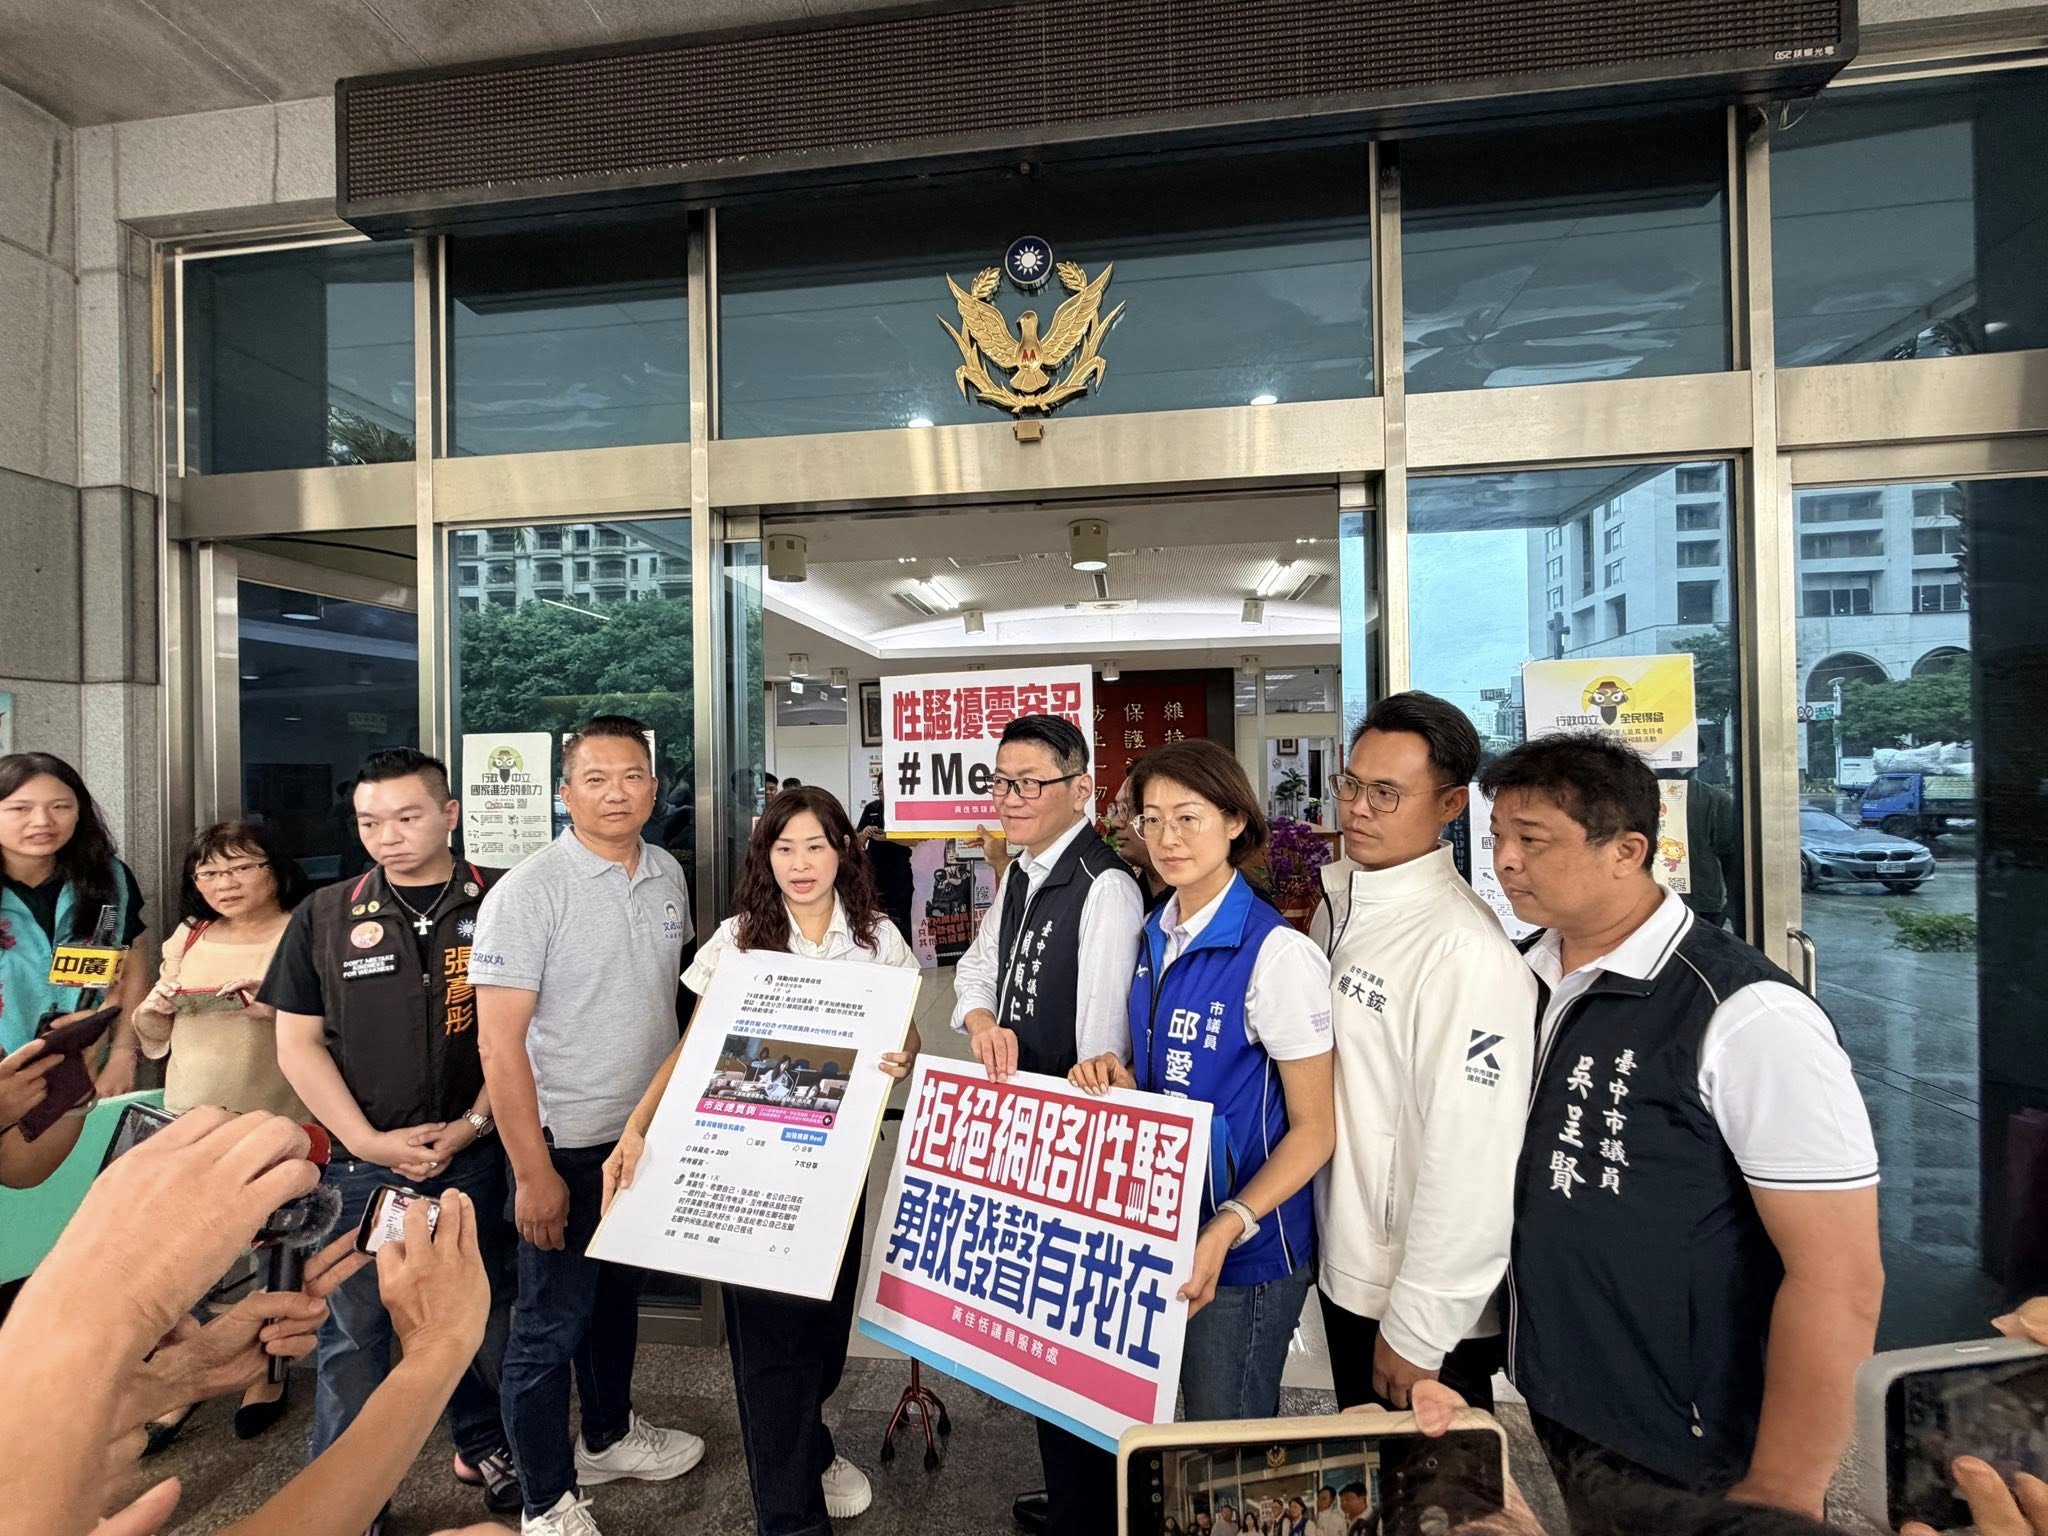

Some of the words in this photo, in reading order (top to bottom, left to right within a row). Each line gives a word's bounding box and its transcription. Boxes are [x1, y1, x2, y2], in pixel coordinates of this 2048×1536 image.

[1556, 715, 1600, 726] 行政中立
[1620, 712, 1664, 724] 全民得益
[471, 784, 543, 796] 國家進步的動力
[482, 773, 499, 783] 行政
[512, 773, 531, 783] 中立
[53, 956, 110, 975] 中廣
[343, 970, 357, 978] FOR
[358, 965, 395, 976] WEAKNESS
[1350, 965, 1385, 988] 台中市議員
[1203, 1001, 1225, 1051] 市議員
[1549, 1055, 1594, 1199] 吳呈賢
[1599, 1049, 1638, 1195] 臺中市議員
[908, 1078, 1189, 1233] 拒絕網路性騷
[885, 1175, 1174, 1370] 勇敢發聲有我在
[951, 1305, 1060, 1366] 黃佳恬議員服務處
